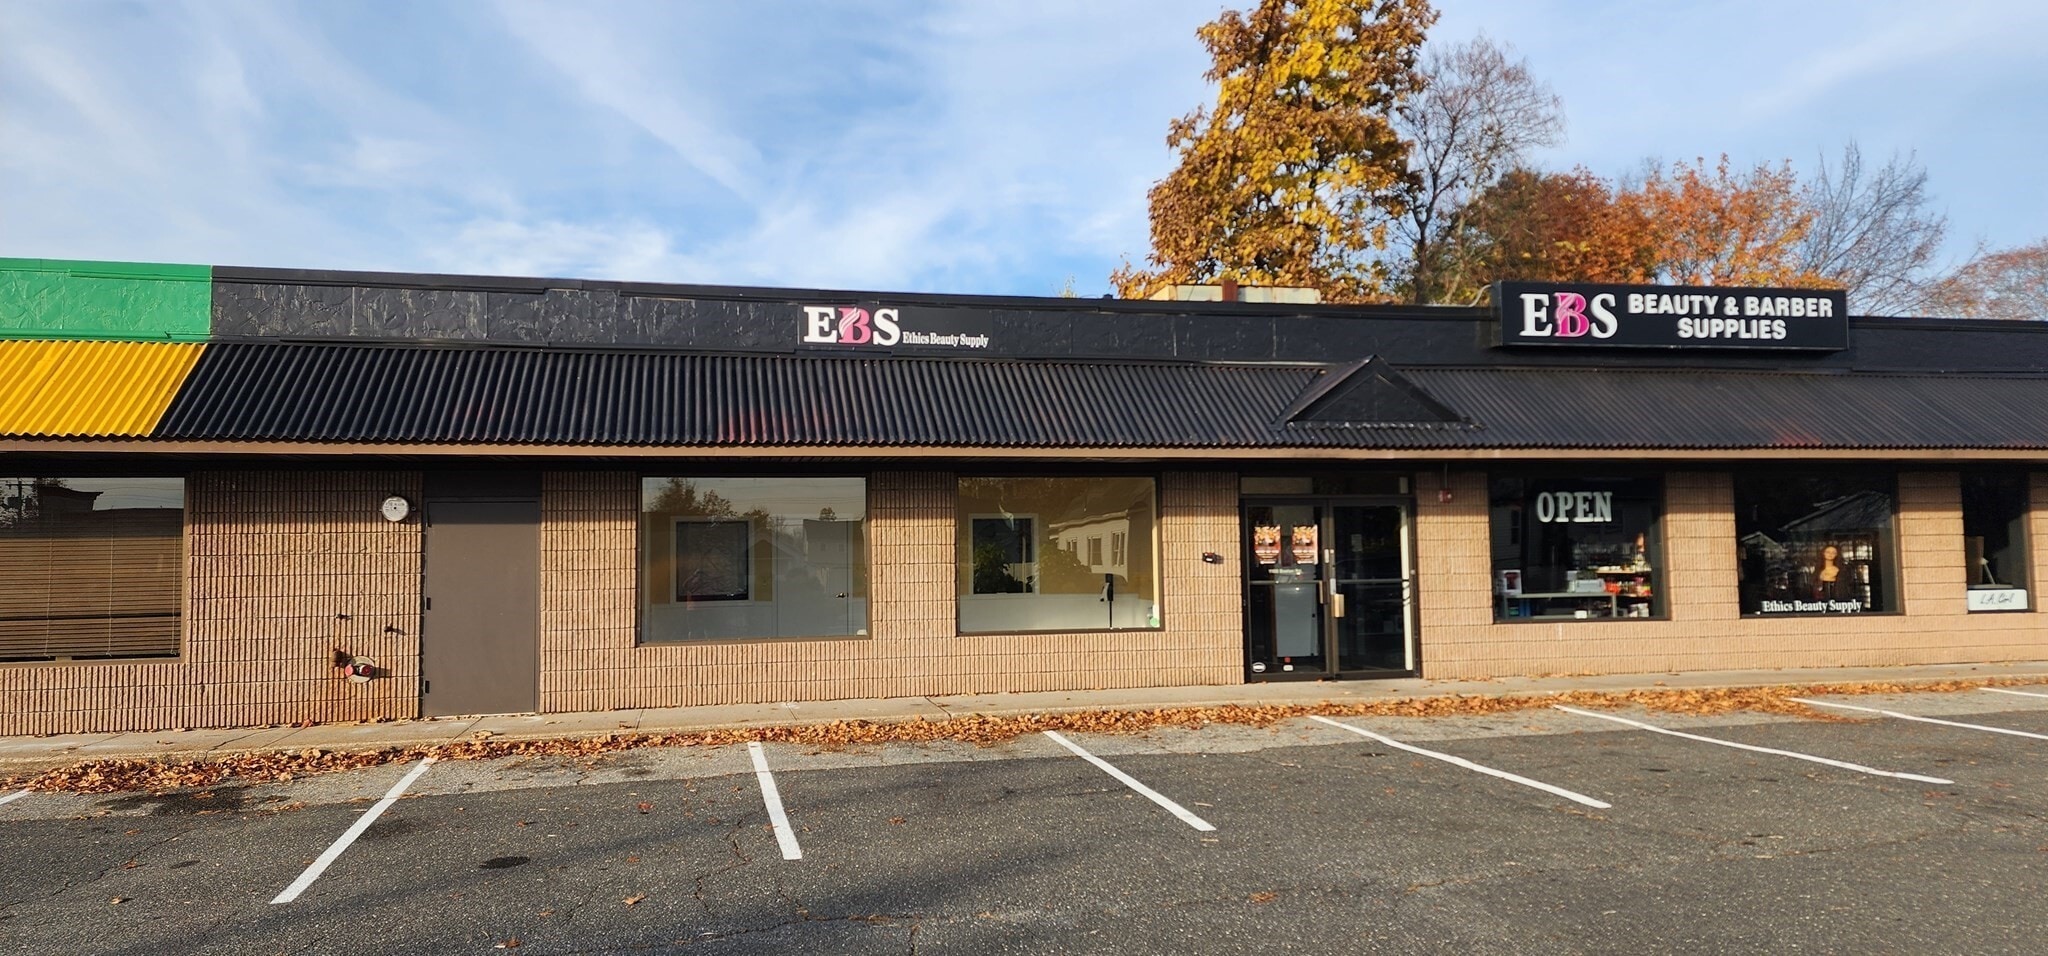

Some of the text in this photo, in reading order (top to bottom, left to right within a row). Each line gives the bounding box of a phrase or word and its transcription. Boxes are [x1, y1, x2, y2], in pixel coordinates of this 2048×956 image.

[1519, 292, 1618, 338] EBS
[1628, 293, 1833, 318] BEAUTY & BARBER
[803, 306, 900, 346] EBS
[1677, 317, 1787, 339] SUPPLIES
[902, 331, 989, 348] Ethics Beauty Supply
[1536, 491, 1613, 523] OPEN
[1761, 598, 1862, 614] Ethics Beauty Supply
